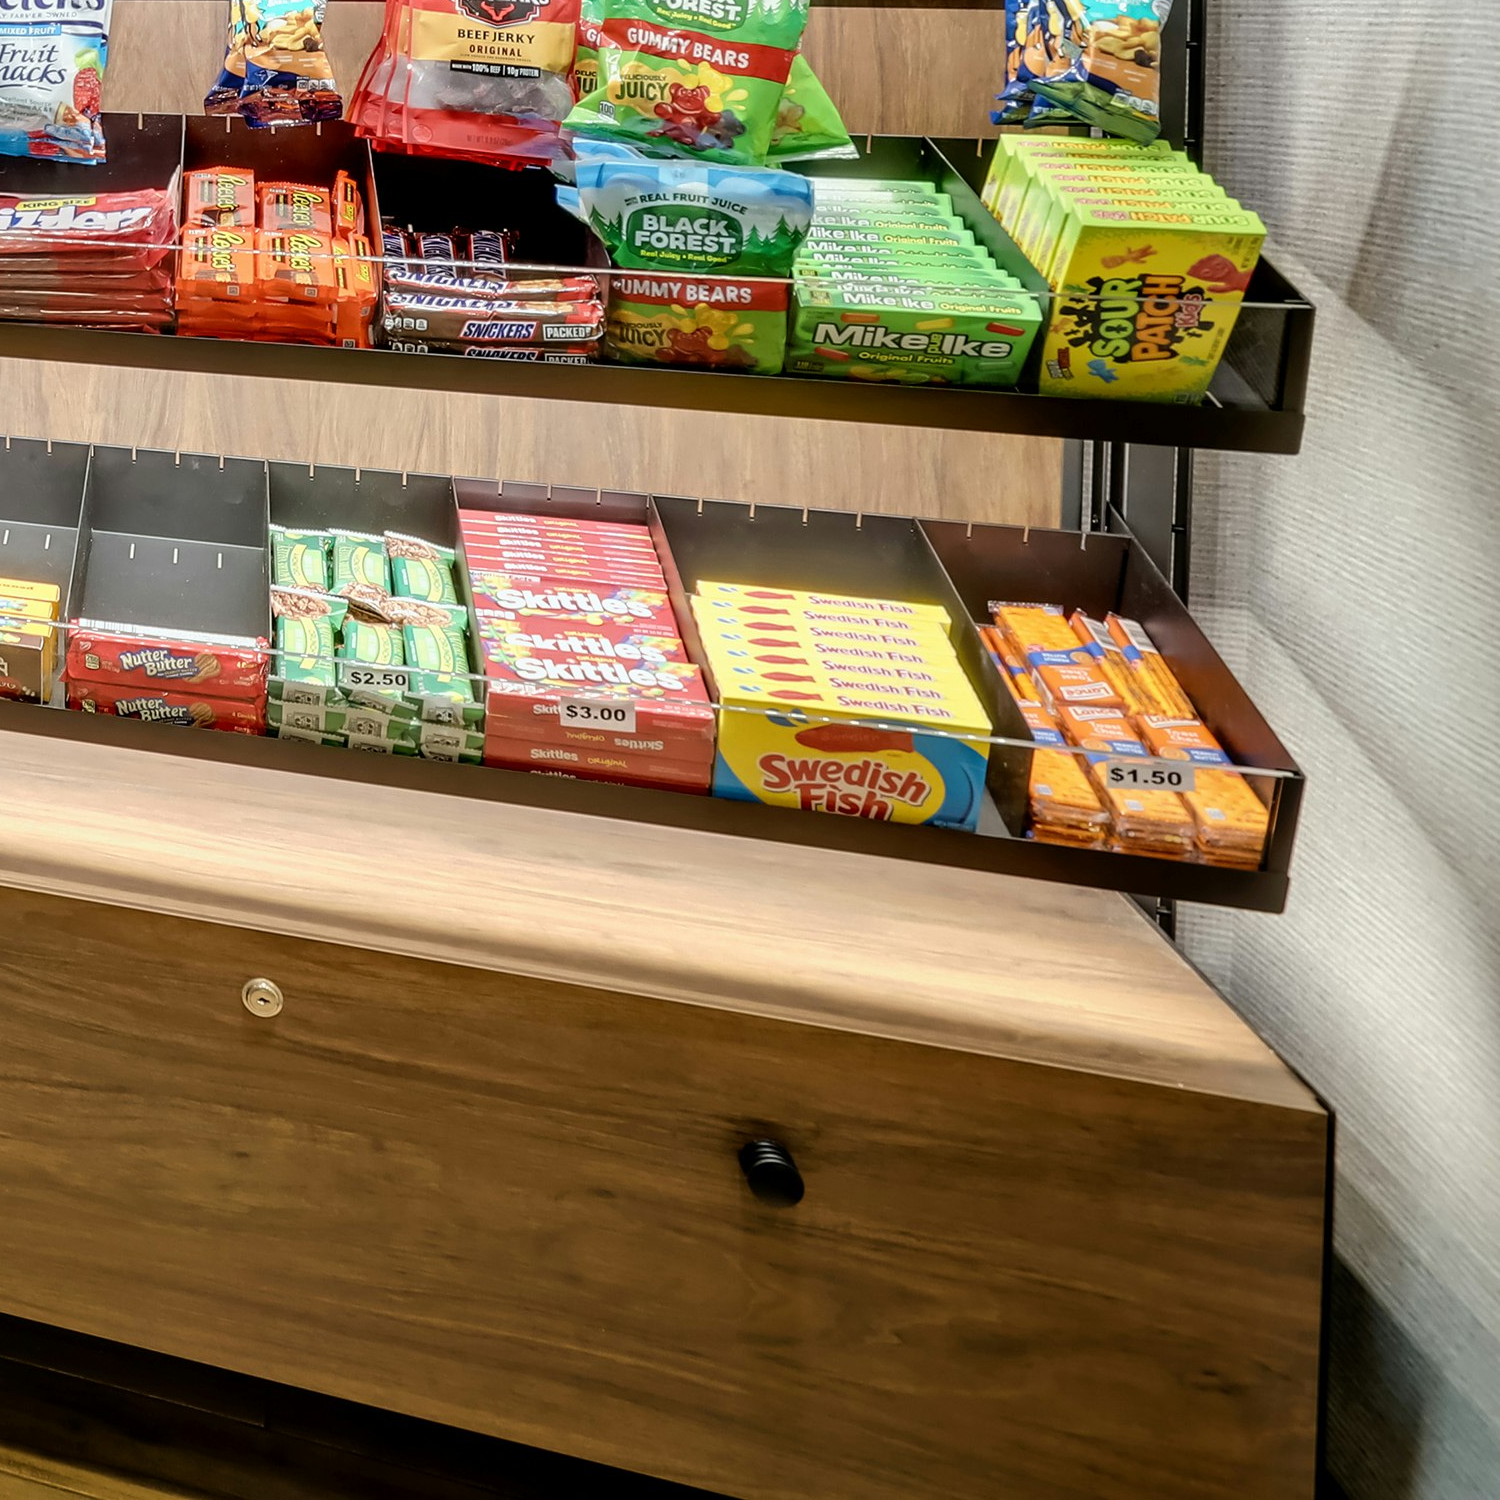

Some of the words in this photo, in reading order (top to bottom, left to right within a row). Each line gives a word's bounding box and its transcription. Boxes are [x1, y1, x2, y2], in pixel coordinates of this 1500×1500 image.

[28, 26, 57, 36] FRUIT
[457, 28, 490, 41] BEEF
[491, 31, 536, 45] JERKY
[469, 45, 523, 58] ORIGINAL
[627, 27, 692, 54] GUMMY
[693, 41, 750, 69] BEARS
[472, 63, 489, 73] 100%
[507, 66, 519, 77] 10g
[615, 82, 670, 101] JUICY
[22, 200, 59, 209] KING
[61, 198, 91, 206] SIZE
[640, 193, 670, 204] REAL
[673, 192, 710, 204] FRUIT
[711, 197, 749, 215] JUICE
[643, 214, 729, 236] BLACK
[686, 284, 752, 304] BEARS
[842, 292, 898, 307] Mike
[903, 297, 936, 311] Ike
[940, 302, 987, 314] Original
[988, 305, 1022, 315] Fruits
[1091, 277, 1142, 358] SOUR
[1130, 274, 1186, 362] PATCH
[1175, 293, 1203, 329] Kids
[463, 322, 535, 339] SNICKERS
[546, 326, 586, 338] PACKED
[813, 323, 930, 351] Mike
[938, 334, 1012, 358] Ike
[858, 351, 914, 363] Original
[916, 354, 954, 365] Fruits
[496, 588, 653, 619] Skittles
[808, 594, 875, 611] Swedish
[878, 602, 915, 615] Fish
[119, 650, 168, 669] Nutter
[145, 657, 193, 677] Butter
[350, 671, 407, 687] $2.50
[515, 657, 685, 691] Skittles
[566, 704, 627, 723] $3.00
[837, 695, 910, 715] Swedish
[911, 704, 952, 718] Fish
[1072, 707, 1117, 717] Lance
[530, 748, 579, 762] Skittles
[760, 754, 928, 803] Swedish
[1110, 767, 1183, 786] $1.50
[799, 783, 891, 820] Fish
